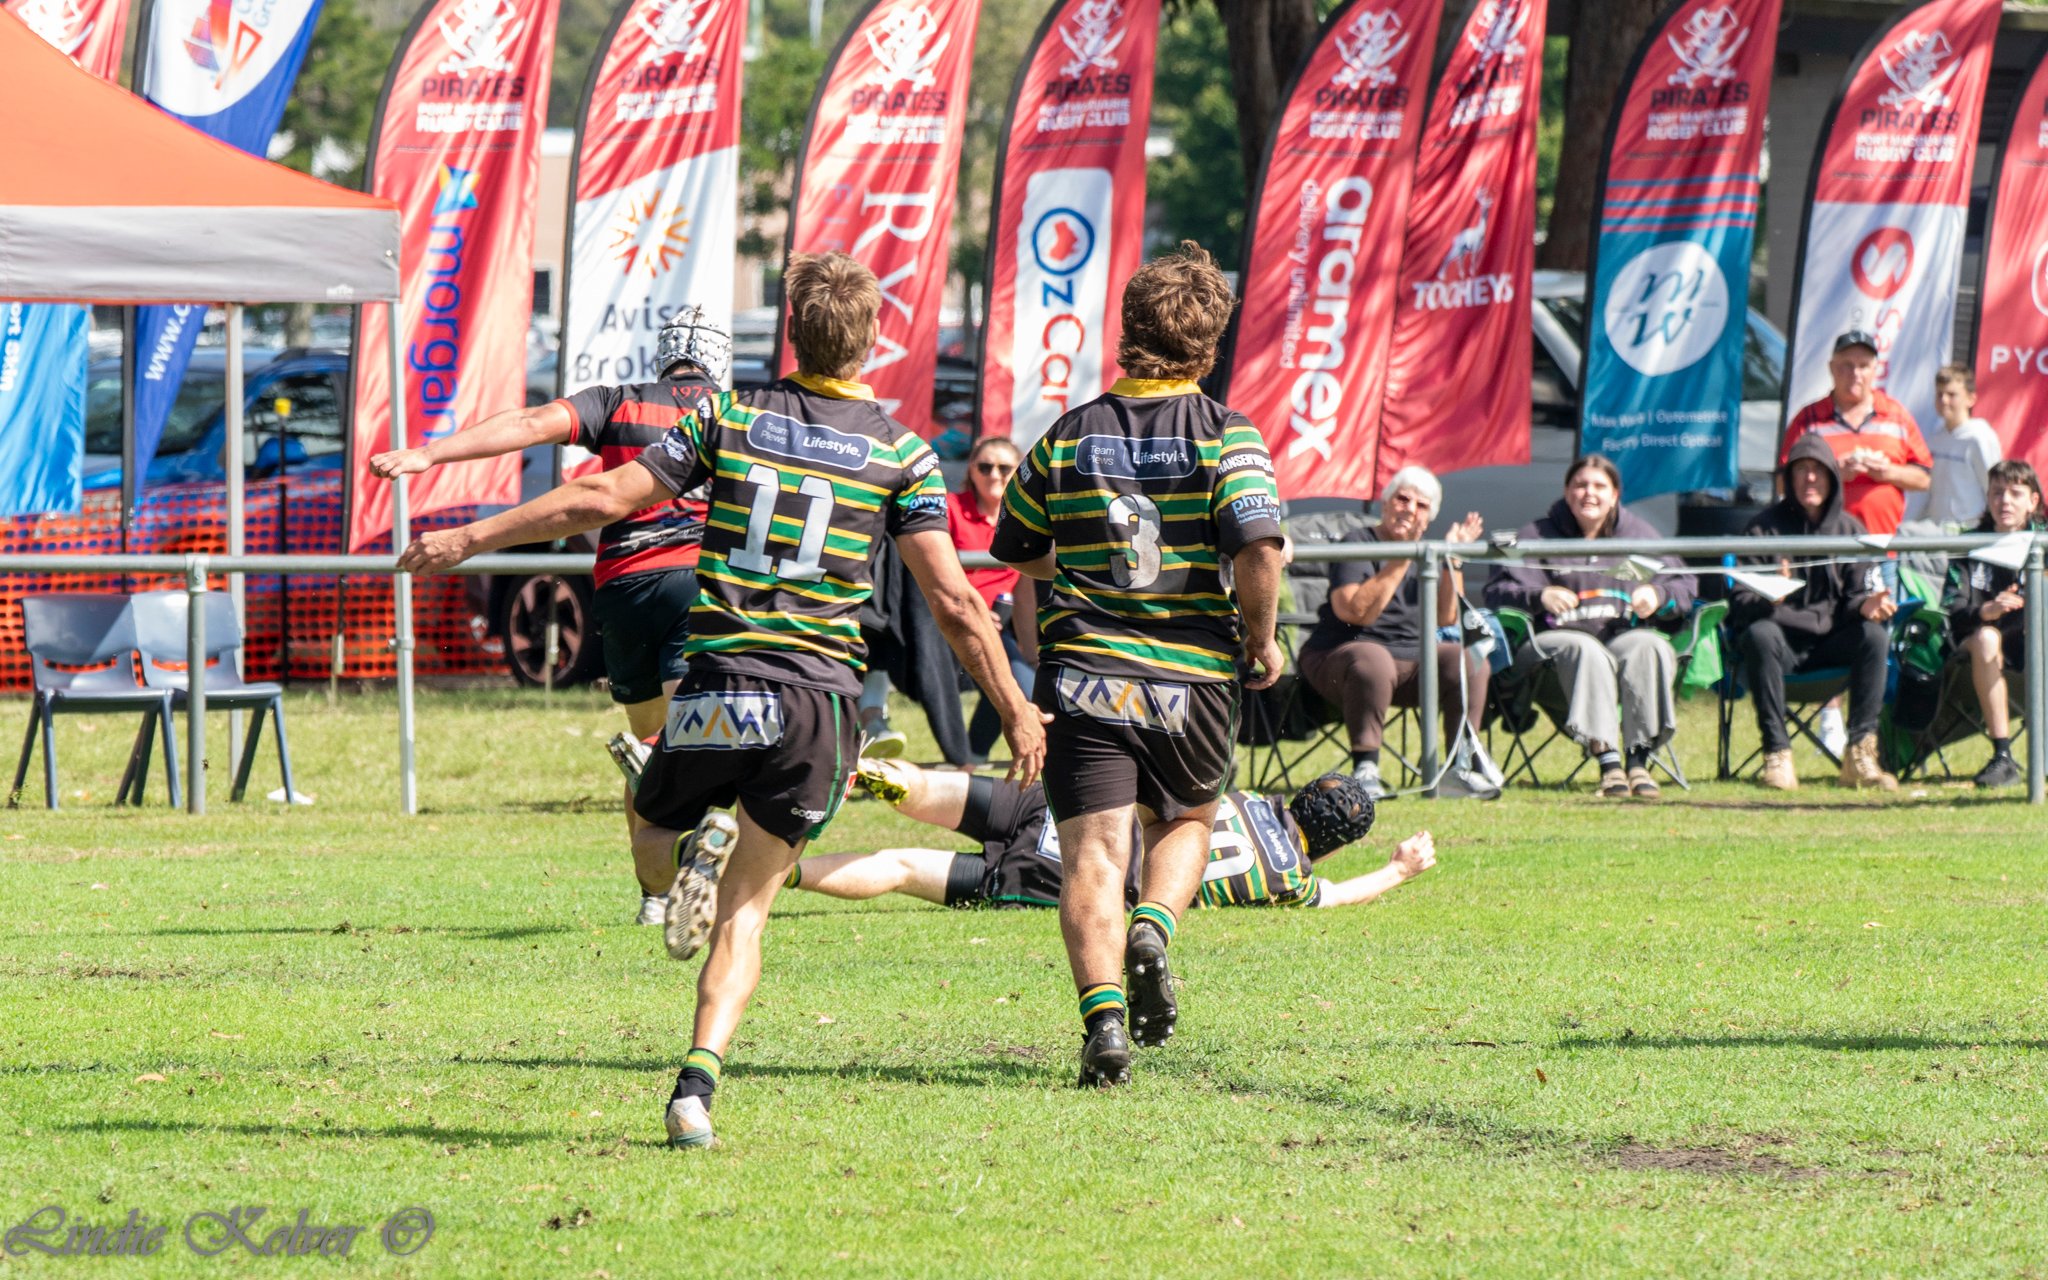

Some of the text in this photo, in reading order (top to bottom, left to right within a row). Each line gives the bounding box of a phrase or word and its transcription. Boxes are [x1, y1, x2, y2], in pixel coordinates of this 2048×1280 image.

[852, 89, 947, 111] PIRATES
[1860, 109, 1961, 131] PIRATES
[1279, 178, 1321, 369] delivery unlimited
[1412, 272, 1515, 312] TOOHEYS
[1289, 175, 1373, 462] aramex
[408, 226, 465, 447] morgan
[1656, 408, 1728, 424] Optometrist
[760, 430, 788, 446] Plews
[765, 421, 862, 458] Team Lifestyle.
[1641, 432, 1679, 448] Direct
[1681, 431, 1724, 448] Optical
[1087, 454, 1114, 466] Plews
[1090, 445, 1189, 468] Team Lifestyle.
[727, 462, 836, 584] 11
[1107, 493, 1162, 590] 3
